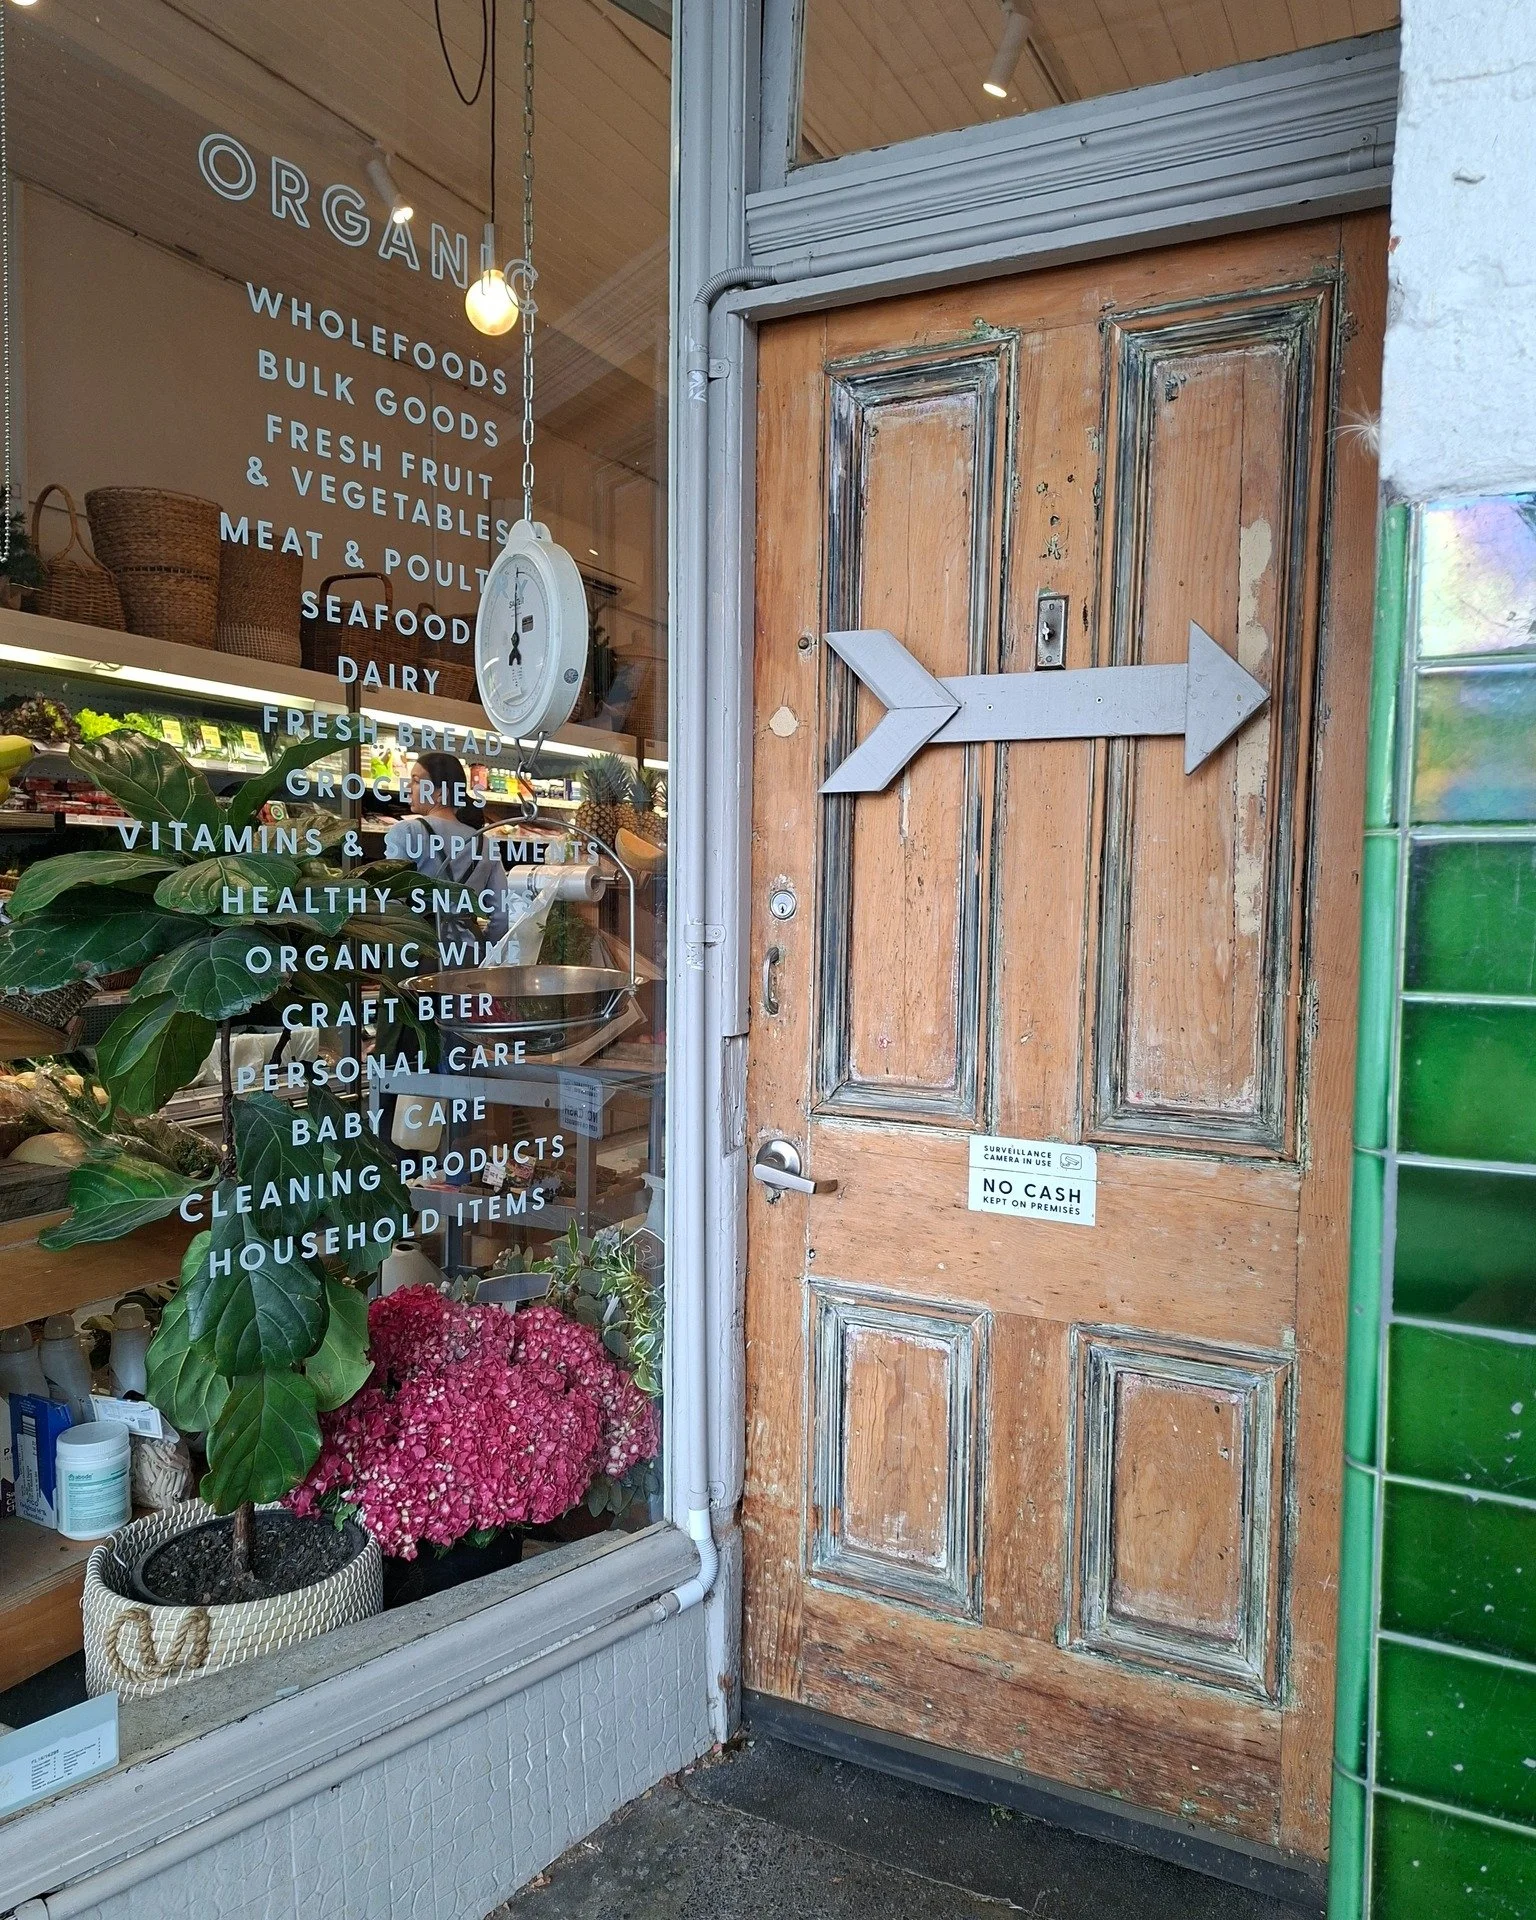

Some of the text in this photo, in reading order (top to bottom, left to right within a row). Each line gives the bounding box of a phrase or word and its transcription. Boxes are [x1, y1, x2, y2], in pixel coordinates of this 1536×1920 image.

[198, 132, 539, 315] ORGANIC
[245, 281, 508, 396] WHOLEFOODS
[257, 348, 499, 448] BULK GOODS
[266, 413, 494, 501] FRESH FRUIT
[246, 456, 510, 545] & VEGETABLES
[220, 512, 323, 561] MEAT
[344, 539, 366, 570] &
[302, 590, 471, 644] SEAFOOD
[338, 654, 441, 696] DAIRY
[262, 705, 379, 743] FRESH
[397, 723, 502, 757] BREAD
[285, 768, 487, 809] GROCERIES
[117, 820, 600, 865] VITAMINS & SUPPLEMENTS
[222, 885, 535, 914] HEALTHY SNACKS
[245, 940, 520, 974] ORGANIC WINE
[282, 992, 494, 1031] CRAFT BEER
[236, 1040, 527, 1094] PERSONAL CARE
[291, 1096, 486, 1147] BABY CARE
[983, 1145, 1052, 1158] SURVEILLANCE
[983, 1153, 1020, 1163] CAMERA
[180, 1166, 381, 1223] CLEANING
[399, 1135, 565, 1185] PRODUCTS
[983, 1178, 1081, 1204] NO CASH
[983, 1196, 1081, 1216] KEPT ON PREMISES
[209, 1187, 546, 1278] HOUSEHOLD ITEMS
